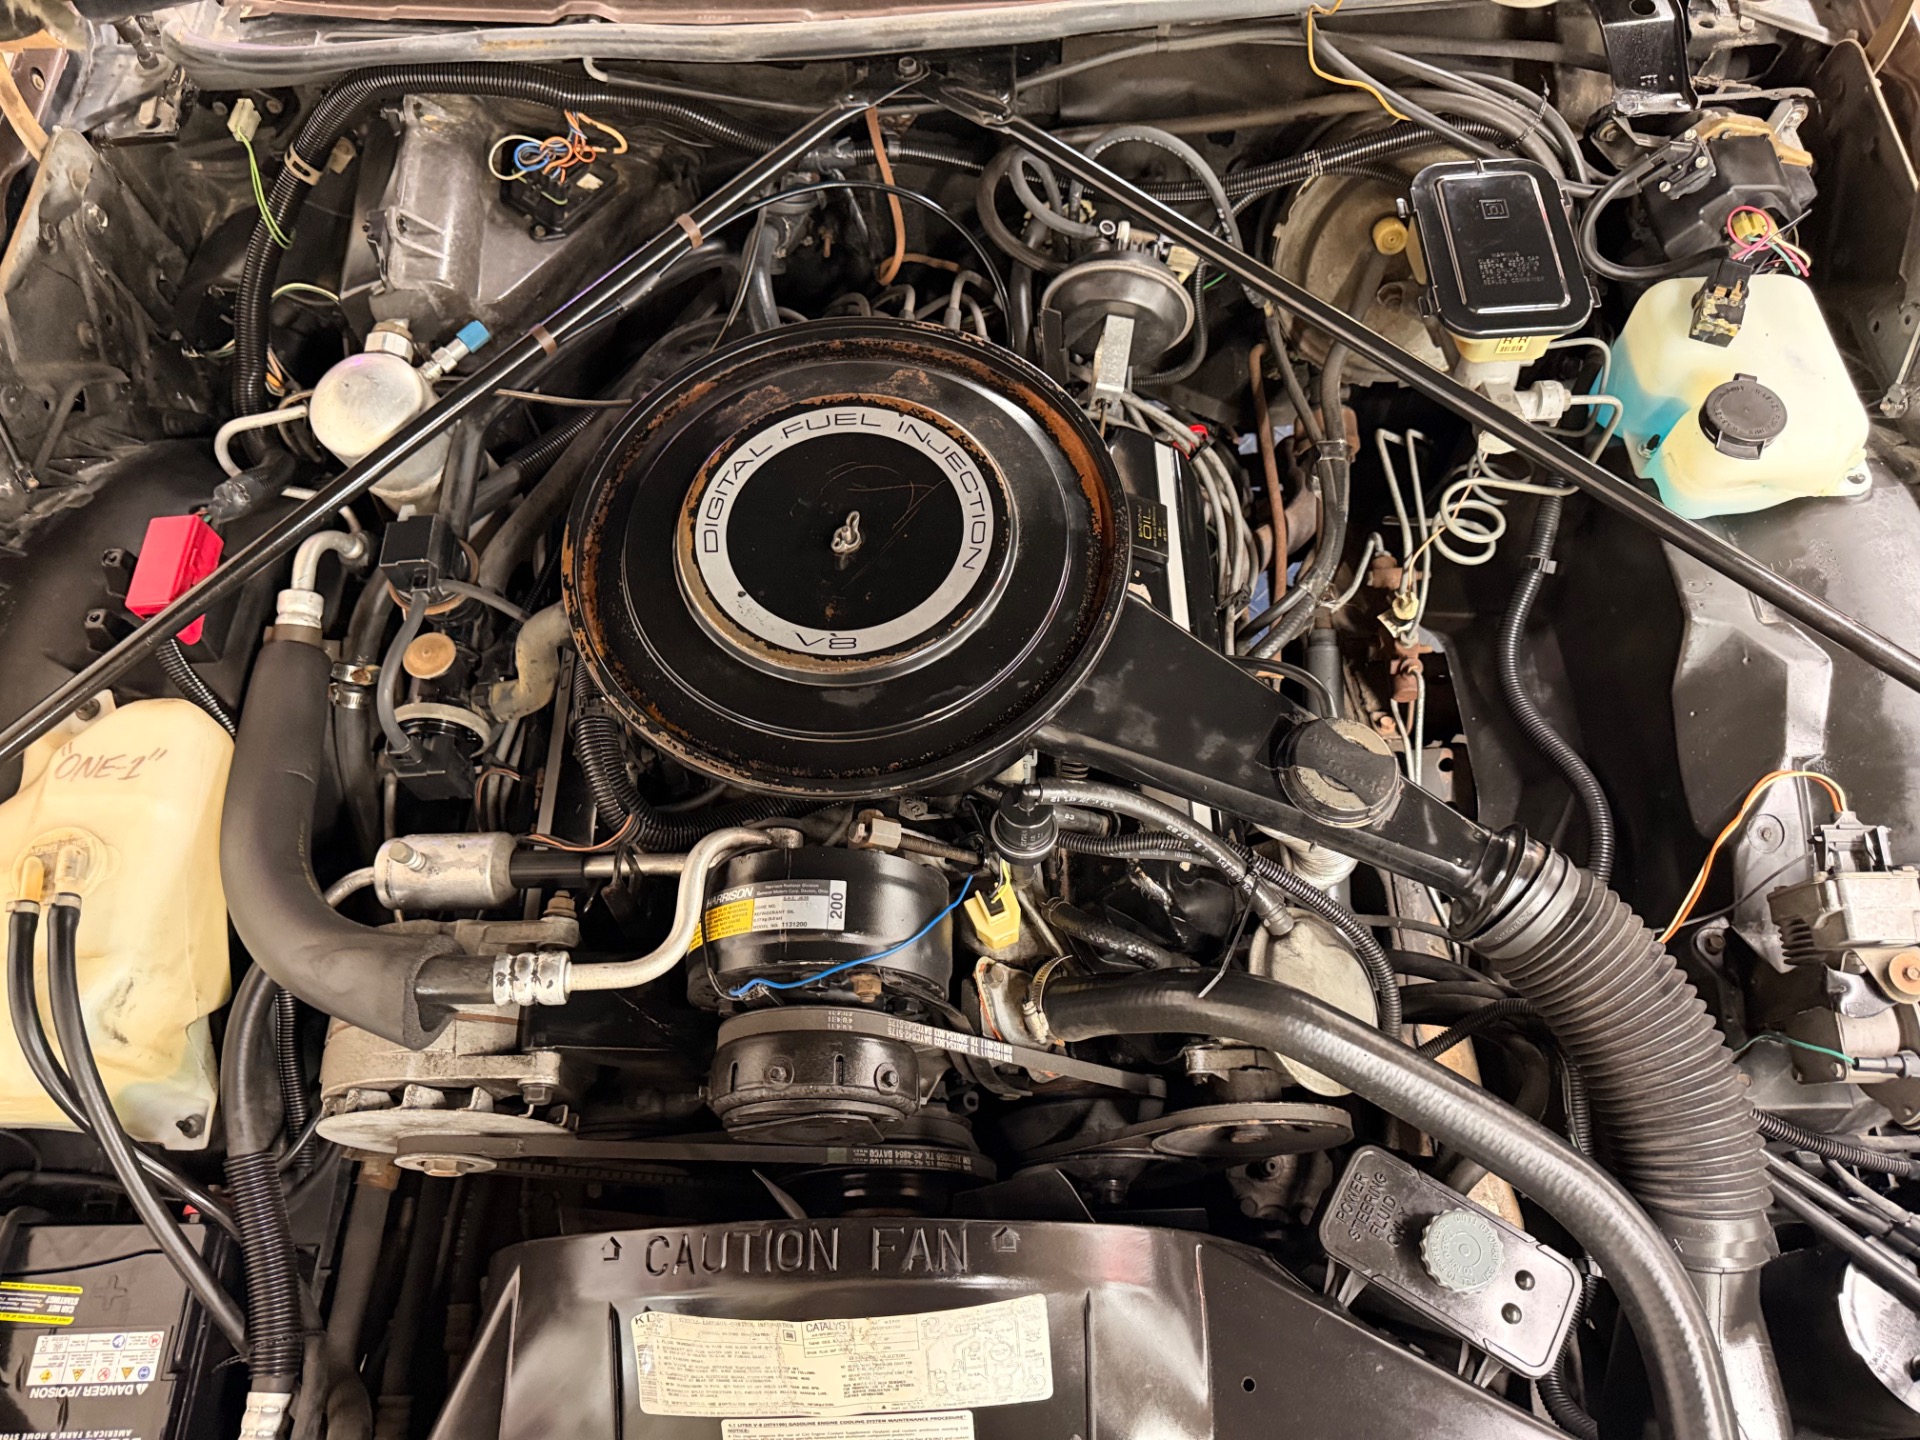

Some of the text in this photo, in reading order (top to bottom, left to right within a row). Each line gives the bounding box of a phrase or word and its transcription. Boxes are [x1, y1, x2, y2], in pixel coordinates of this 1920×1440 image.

[703, 412, 987, 570] DIGITAL FUEL INJECTION
[1142, 508, 1152, 540] OIL
[796, 632, 858, 651] V8
[706, 886, 754, 908] HARRISON
[830, 892, 844, 920] 200
[869, 1149, 893, 1158] DAYCO
[1335, 1171, 1369, 1224] POWER
[1348, 1171, 1388, 1242] STEERING
[1370, 1195, 1397, 1239] FLUID
[644, 1226, 968, 1277] CAUTION FAN
[805, 1321, 852, 1333] CATALYST
[59, 1430, 83, 1439] FARM
